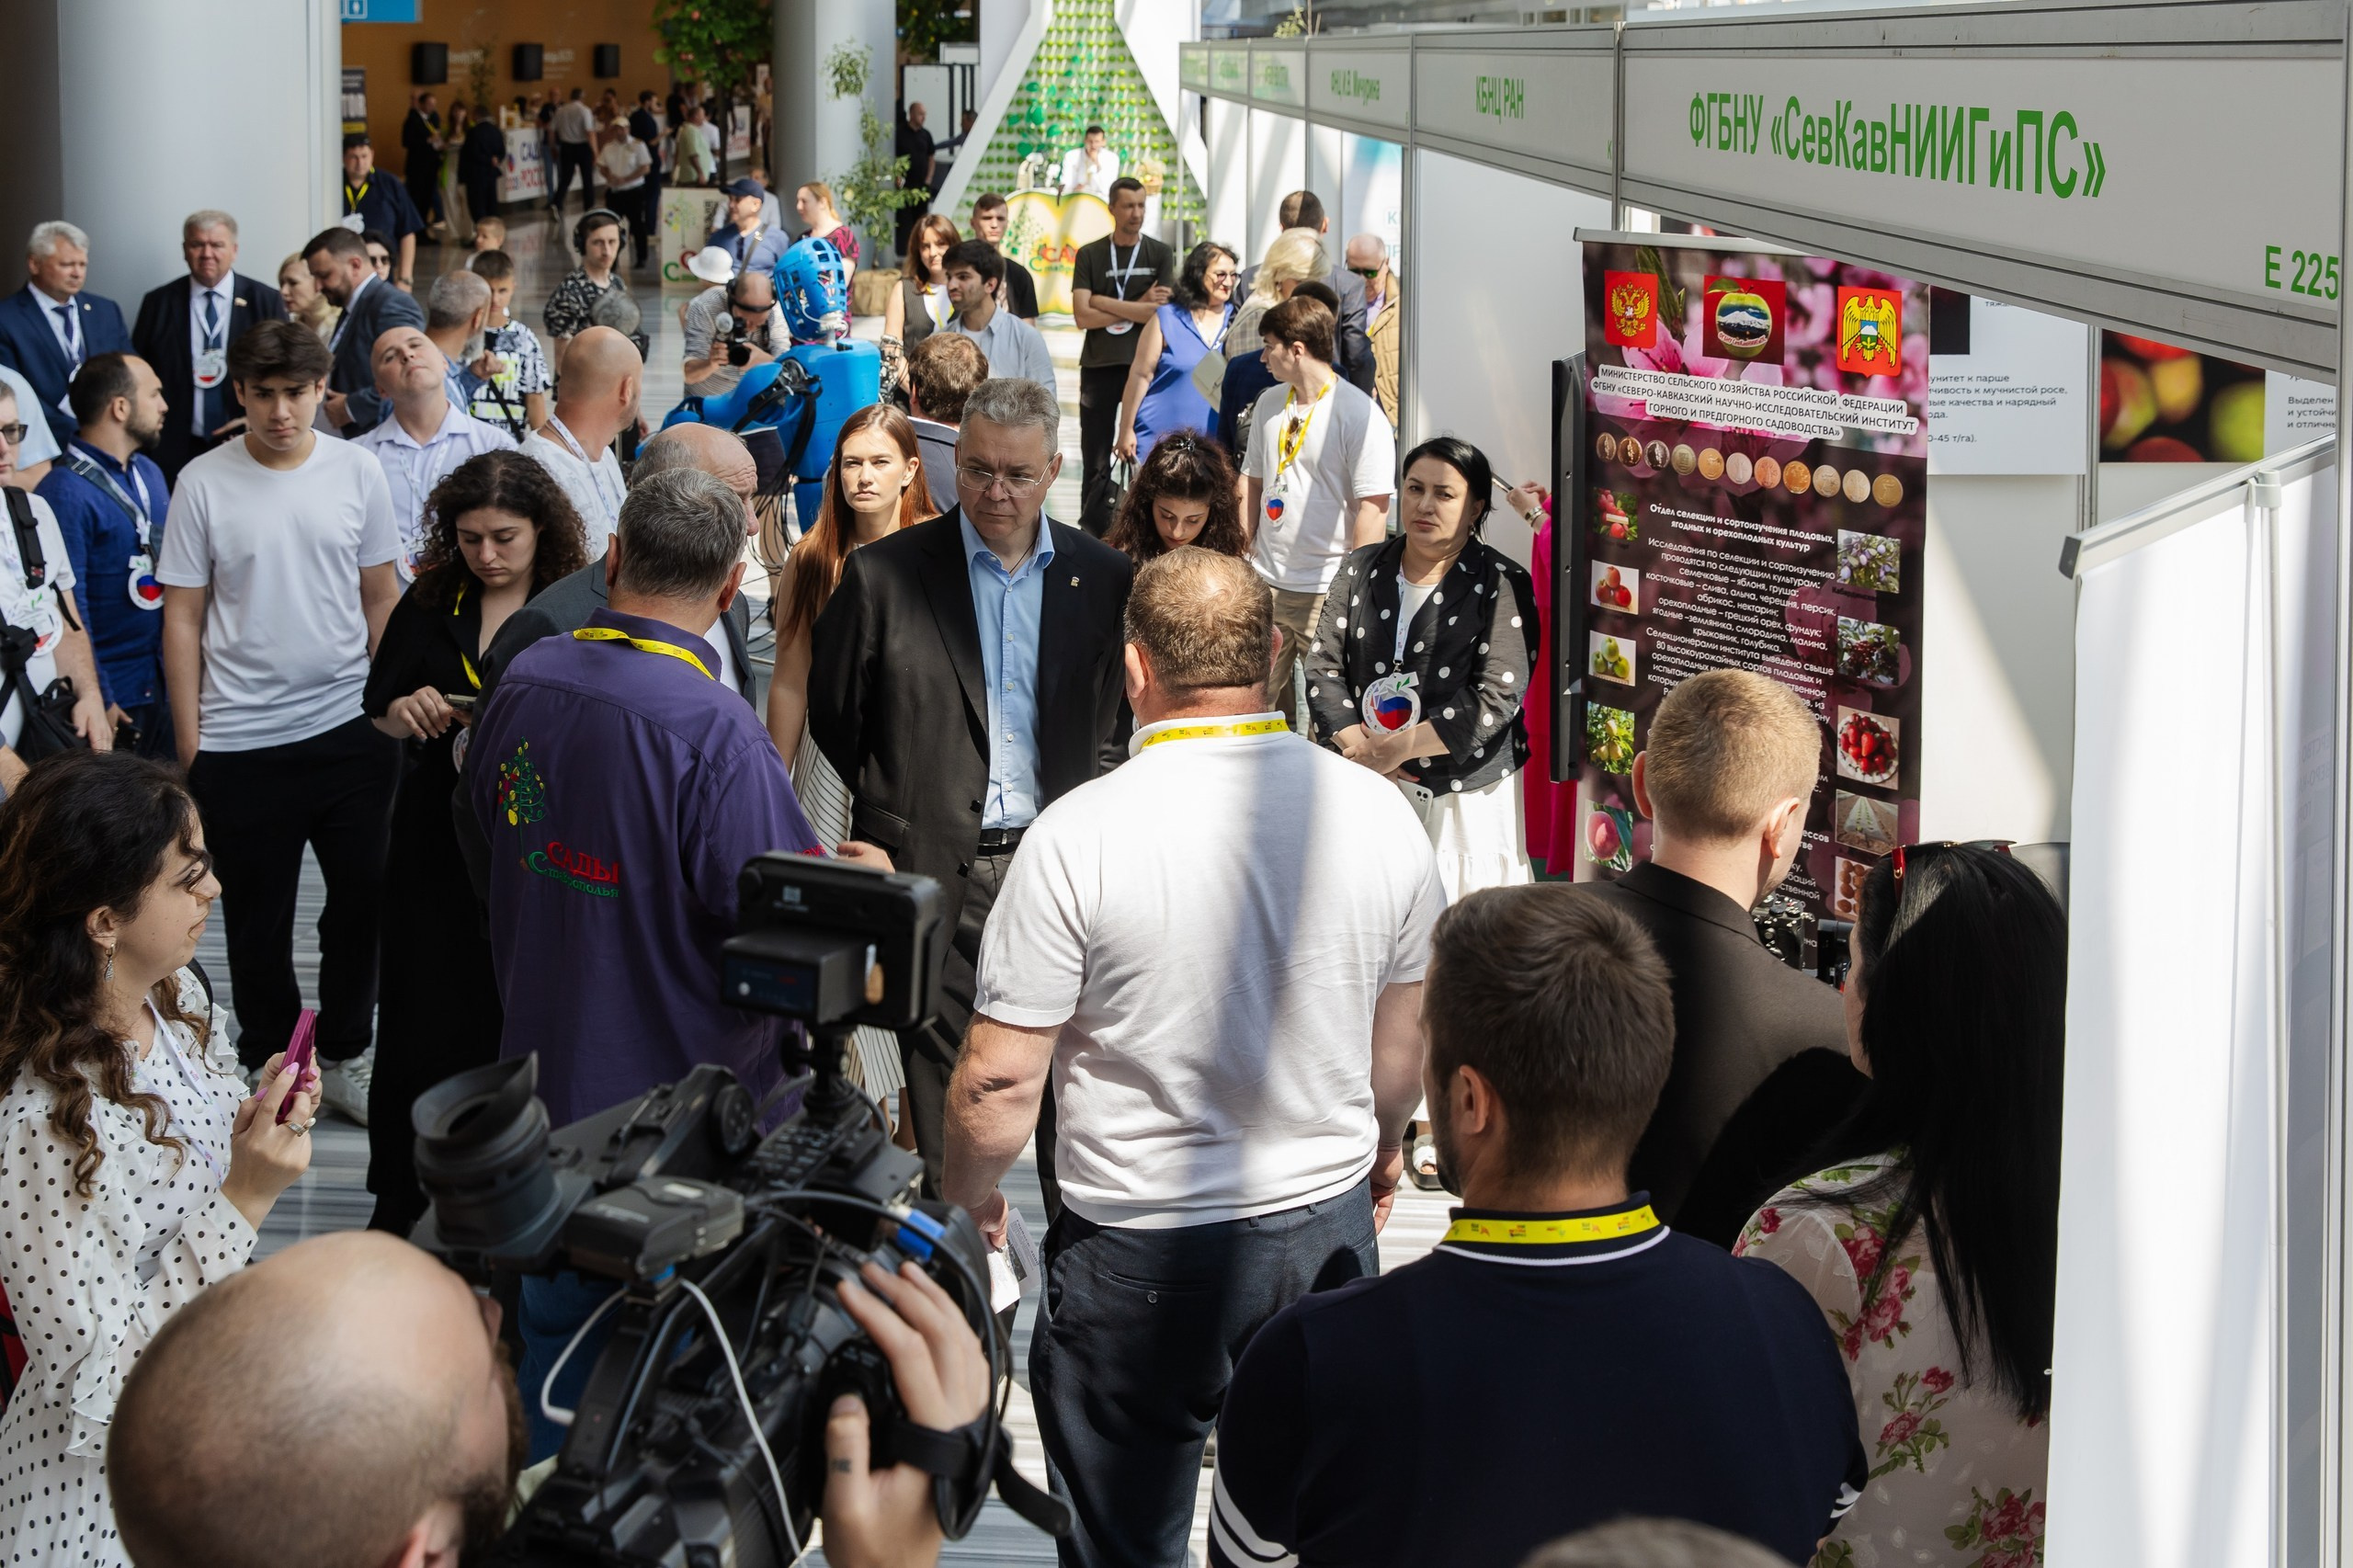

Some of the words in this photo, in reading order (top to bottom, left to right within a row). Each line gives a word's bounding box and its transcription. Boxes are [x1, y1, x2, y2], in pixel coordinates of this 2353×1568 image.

[1476, 75, 1502, 126] КБНЦ
[1504, 77, 1524, 120] РАН
[1689, 92, 1763, 154] ФГБНУ
[1770, 96, 2106, 199] «СевКавНИИГиПС»
[2290, 250, 2338, 300] 225
[1601, 369, 1665, 384] МИНИСТЕРСТВО
[1668, 377, 1716, 391] СЕЛЬСКОГО
[1719, 383, 1770, 397] ХОЗЯЙСТВА
[1773, 390, 1836, 405] РОССИЙСКОЙ
[1842, 399, 1903, 415] ФЕДЕРАЦИИ
[1976, 375, 2009, 385] парше
[1984, 386, 2038, 395] мучнистой
[2040, 387, 2067, 395] росе,
[1593, 381, 1616, 392] ФГБНУ
[1618, 385, 1712, 404] «СЕВЕРО-КАВКАЗСКИЙ
[1716, 396, 1859, 424] НАУЧНО-ИССЛЕДОВАТЕЛЬСКИЙ
[1862, 415, 1915, 431] ИНСТИТУТ
[2006, 398, 2056, 406] нарядный
[2288, 396, 2334, 404] Выделен
[1649, 403, 1688, 415] ГОРНОГО
[1690, 409, 1697, 417] И
[1699, 410, 1763, 426] ПРЕДГОРНОГО
[1766, 418, 1839, 437] САДОВОДСТВА»
[1650, 504, 1675, 516] Отдел
[1677, 510, 1715, 522] селекции
[1724, 518, 1788, 536] сортоизучения
[1790, 529, 1835, 544] плодовых,
[1671, 521, 1704, 533] ягодных
[1712, 528, 1774, 545] орехоплодных
[1776, 540, 1811, 552] культур
[1648, 538, 1705, 555] Исследования
[1719, 552, 1759, 565] селекции
[1768, 562, 1836, 579] сортоизучению
[1661, 553, 1705, 567] проводятся
[1719, 564, 1770, 579] следующим
[1646, 573, 1694, 587] косточковые
[1702, 584, 1728, 595] слива,
[1730, 589, 1757, 600] алыча,
[1759, 595, 1799, 609] черешня,
[1802, 603, 1836, 616] персик,
[1679, 568, 1729, 583] семечковые
[1737, 578, 1768, 591] яблоня,
[1658, 597, 1717, 615] орехоплодные
[1724, 611, 1758, 624] грецкий
[1760, 619, 1783, 630] орех,
[1697, 594, 1735, 608] абрикос,
[1653, 608, 1683, 619] ягодные
[1735, 625, 1788, 642] смородина,
[1790, 637, 1828, 651] малина,
[1693, 628, 1739, 643] крыжовник,
[1646, 627, 1718, 650] Селекционерами
[1720, 645, 1759, 659] института
[1762, 654, 1802, 669] выведено
[1803, 664, 1834, 676] свыше
[1652, 653, 1709, 670] орехоплодных
[1656, 641, 1665, 650] 80
[1667, 645, 1741, 666] высокоурожайных
[1743, 662, 1771, 674] сортов
[1774, 668, 1814, 683] плодовых
[546, 841, 619, 883] САДЫ
